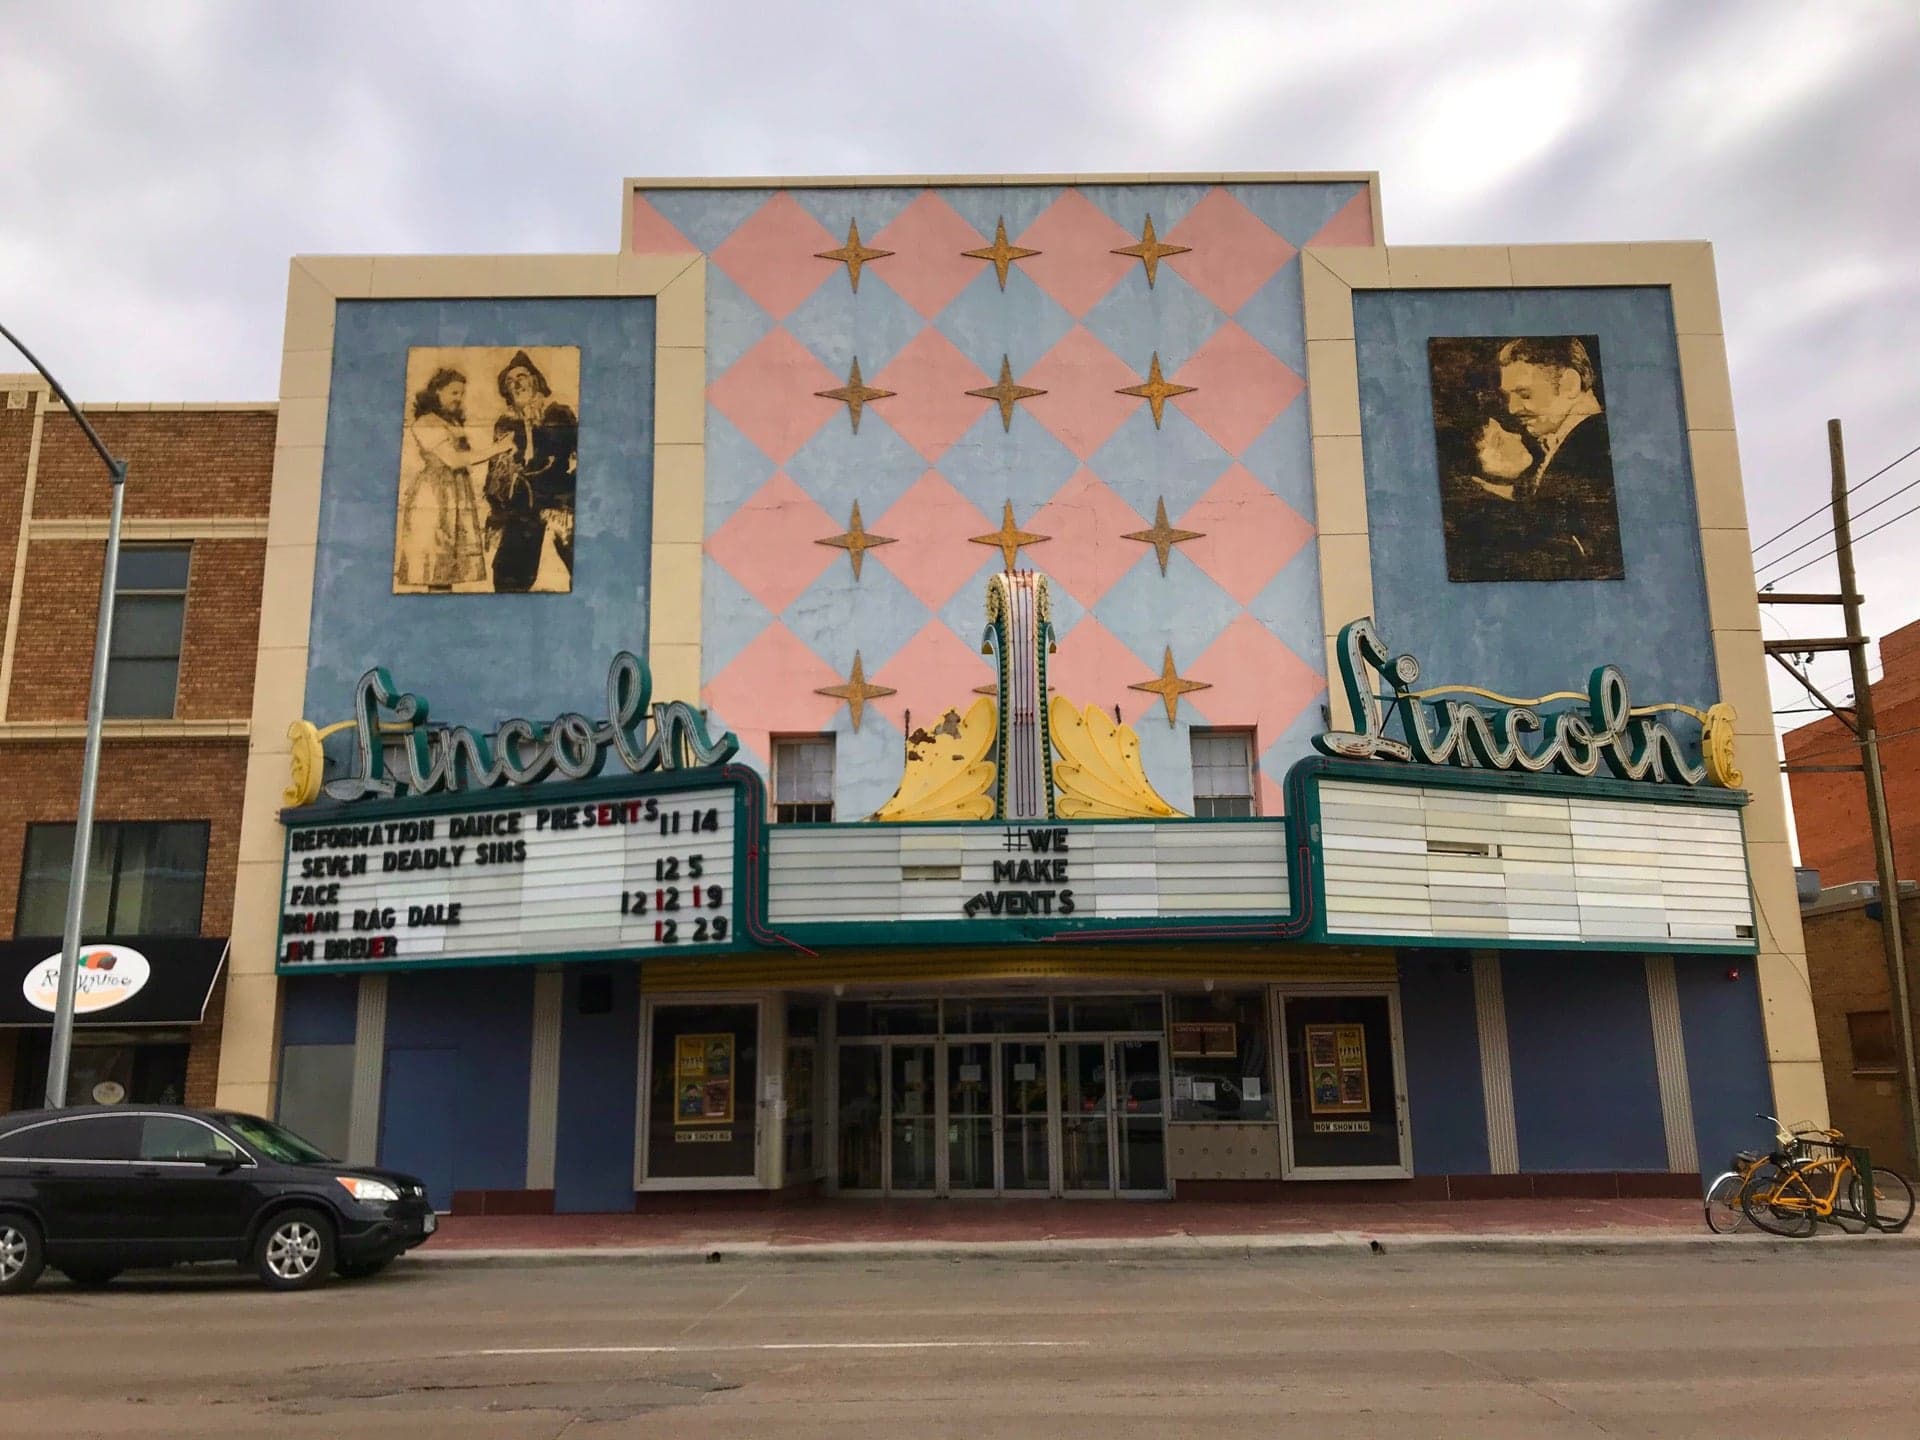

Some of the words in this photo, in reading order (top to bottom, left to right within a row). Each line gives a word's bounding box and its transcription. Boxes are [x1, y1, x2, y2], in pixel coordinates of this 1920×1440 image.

[1311, 616, 1708, 786] Lincoln
[324, 650, 740, 800] Lincoln
[291, 819, 434, 853] REFORMATION
[449, 811, 522, 839] DANCE
[536, 798, 659, 832] PRESENTS
[660, 810, 680, 836] 11
[692, 808, 719, 833] 14
[1003, 827, 1069, 853] #WE
[301, 853, 367, 879] SEVEN
[382, 845, 466, 872] DEADLY
[475, 839, 527, 866] SINS
[656, 856, 680, 881] 12
[688, 854, 703, 878] 5
[993, 858, 1069, 884] MAKE
[290, 883, 341, 906] FACE
[620, 890, 648, 915] 12
[656, 886, 680, 912] 12
[963, 889, 1075, 918] EVENTS
[282, 911, 340, 935] BRIAN
[352, 907, 397, 932] RAG
[407, 903, 462, 927] DALE
[654, 918, 679, 944] 12
[692, 915, 729, 943] 29
[280, 940, 315, 964] JIM
[324, 935, 398, 962] BREUER
